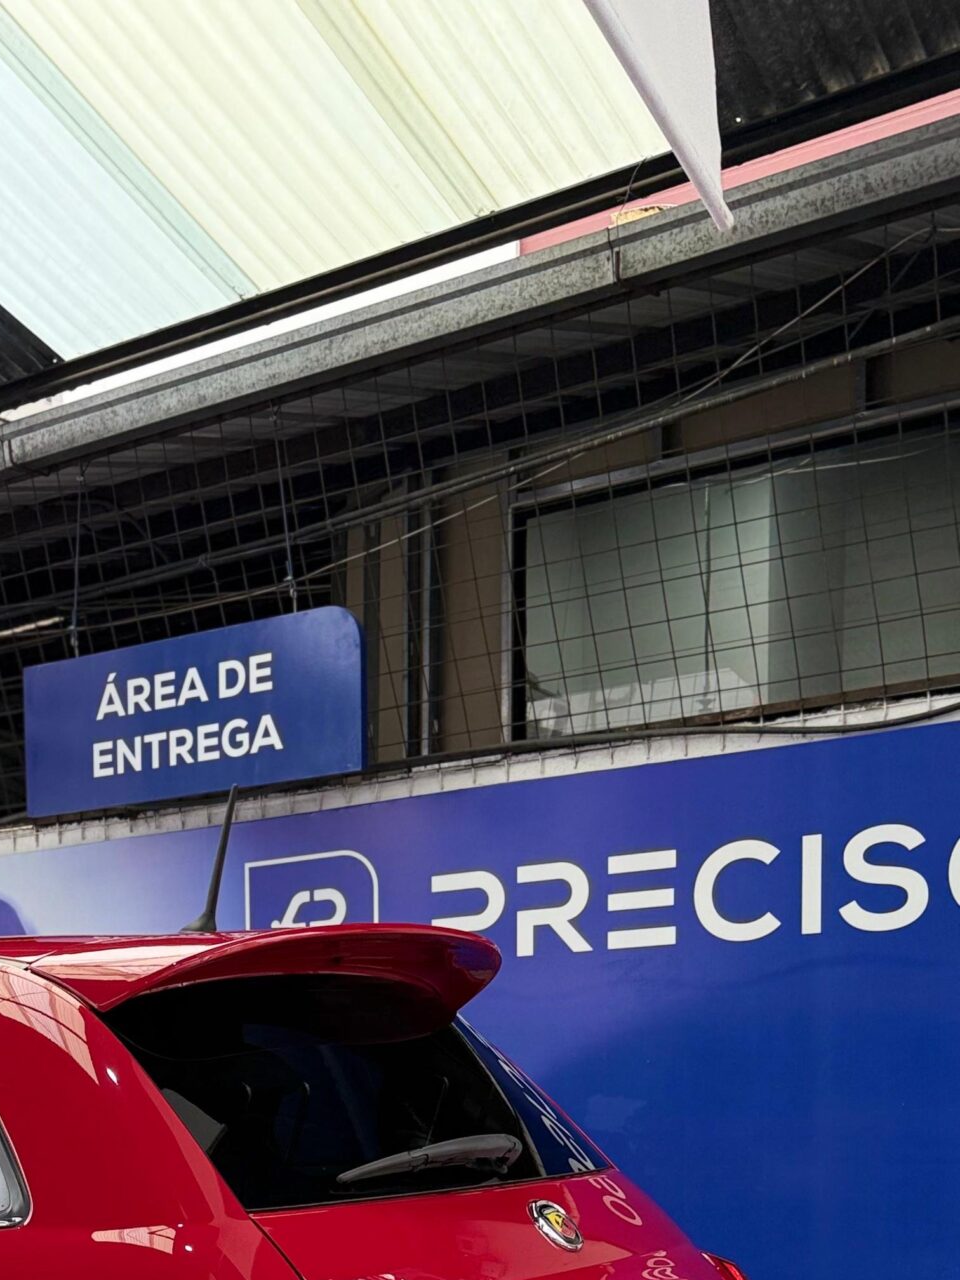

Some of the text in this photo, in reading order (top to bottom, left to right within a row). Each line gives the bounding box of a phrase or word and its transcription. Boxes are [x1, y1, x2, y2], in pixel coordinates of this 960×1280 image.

[96, 652, 273, 721] ÁREA DE
[93, 714, 284, 778] ENTREGA
[431, 824, 960, 957] PRECIS
